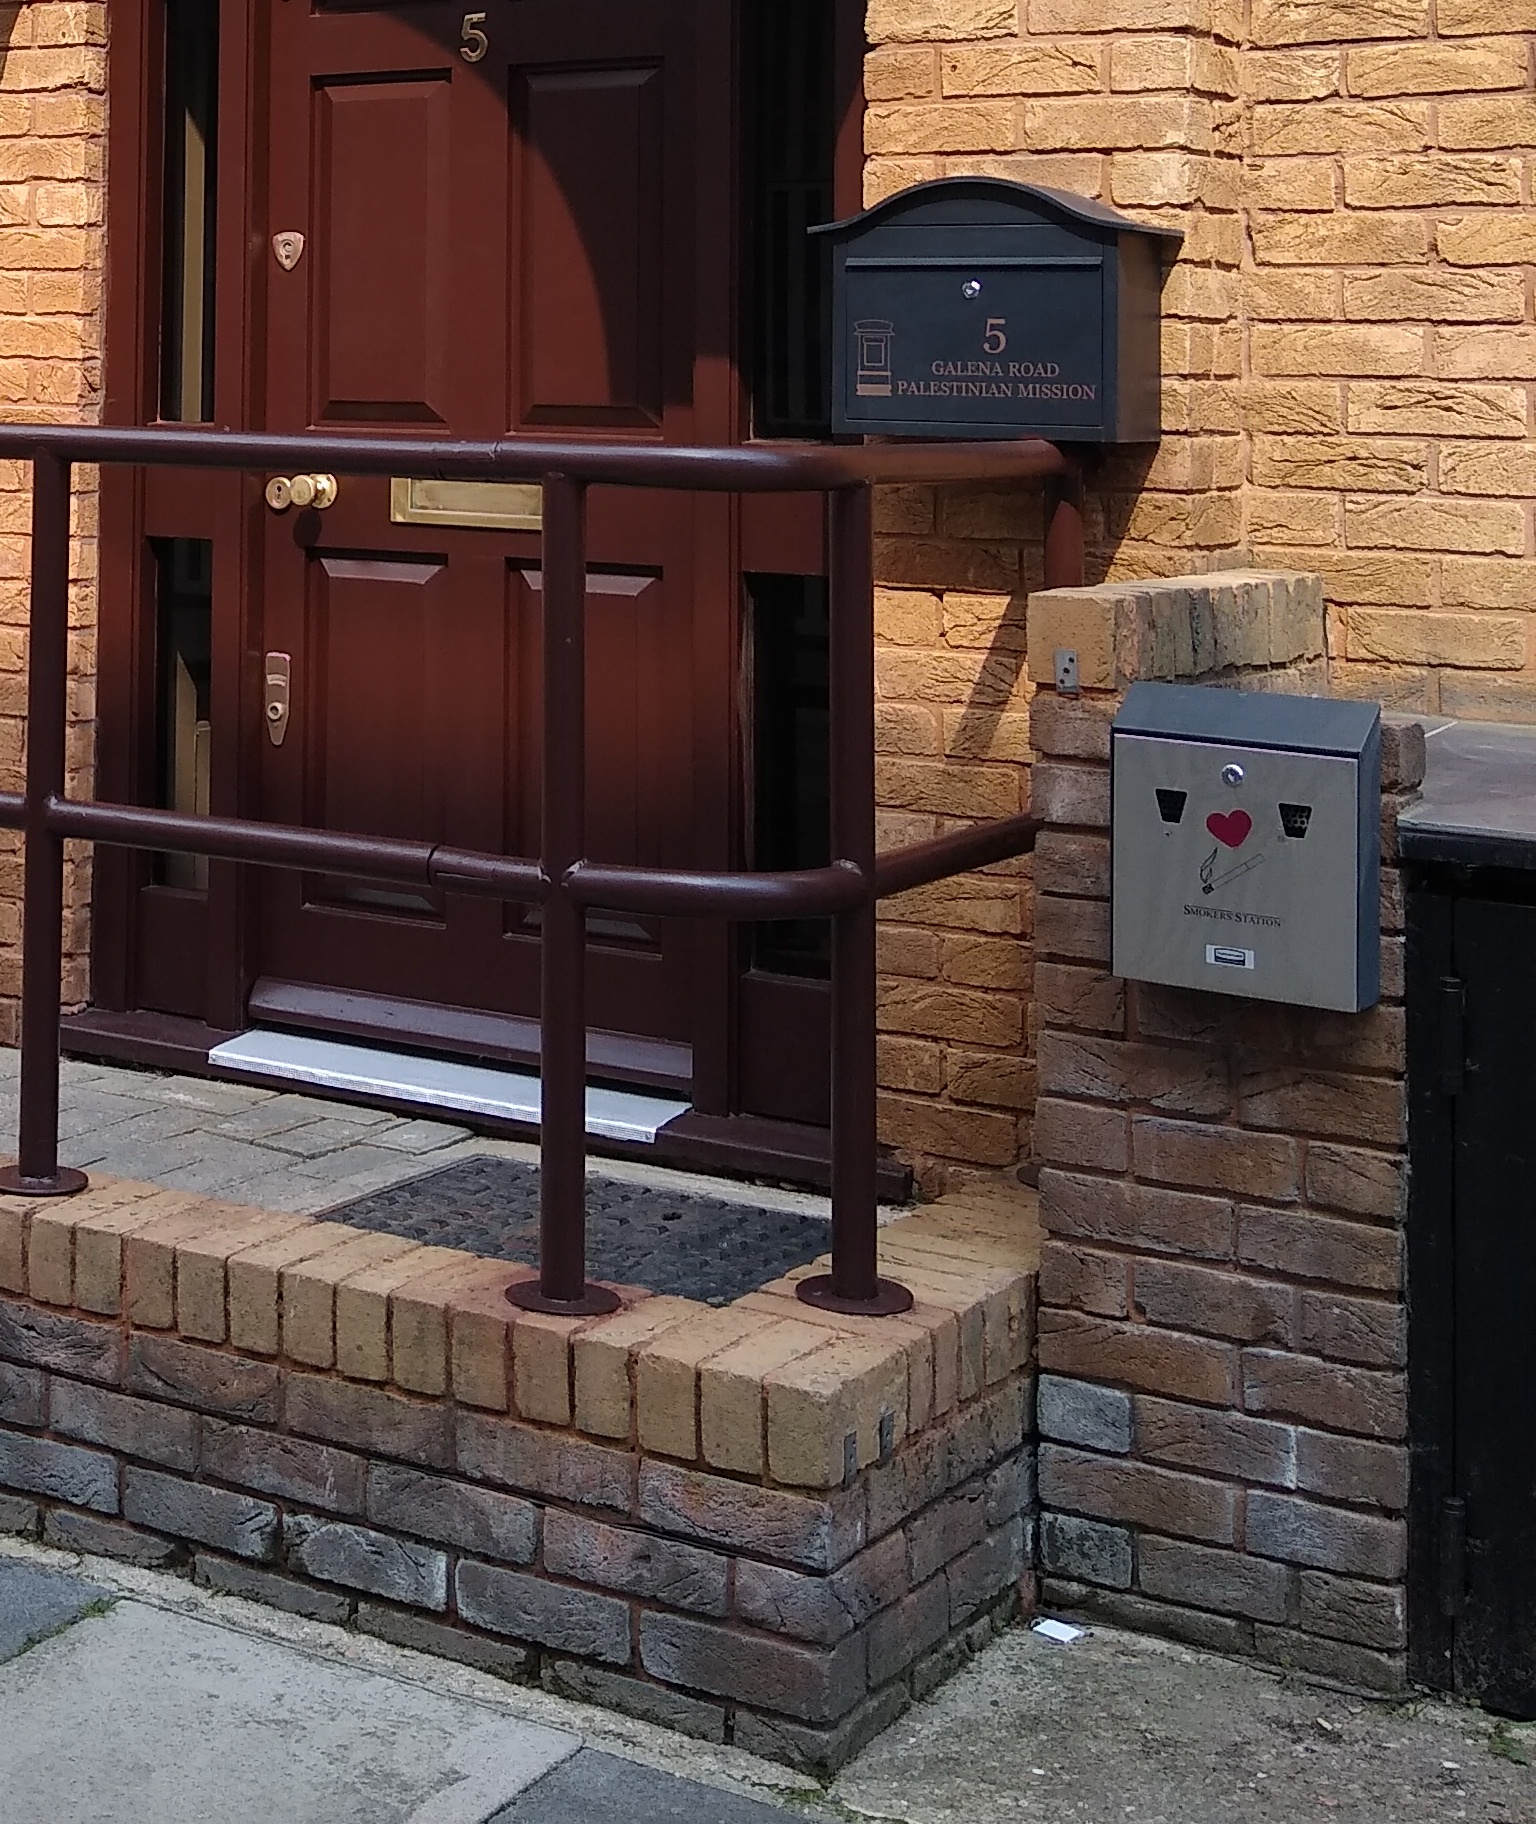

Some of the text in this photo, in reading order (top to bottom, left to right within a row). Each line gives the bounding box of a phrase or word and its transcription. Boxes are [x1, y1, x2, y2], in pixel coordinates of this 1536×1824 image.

[459, 12, 489, 63] 5
[983, 317, 1008, 354] 5
[931, 360, 1060, 377] GALENA ROAD
[896, 380, 1096, 400] PALESTINIAN MISSION
[1183, 904, 1281, 928] SMOKERS STATION
